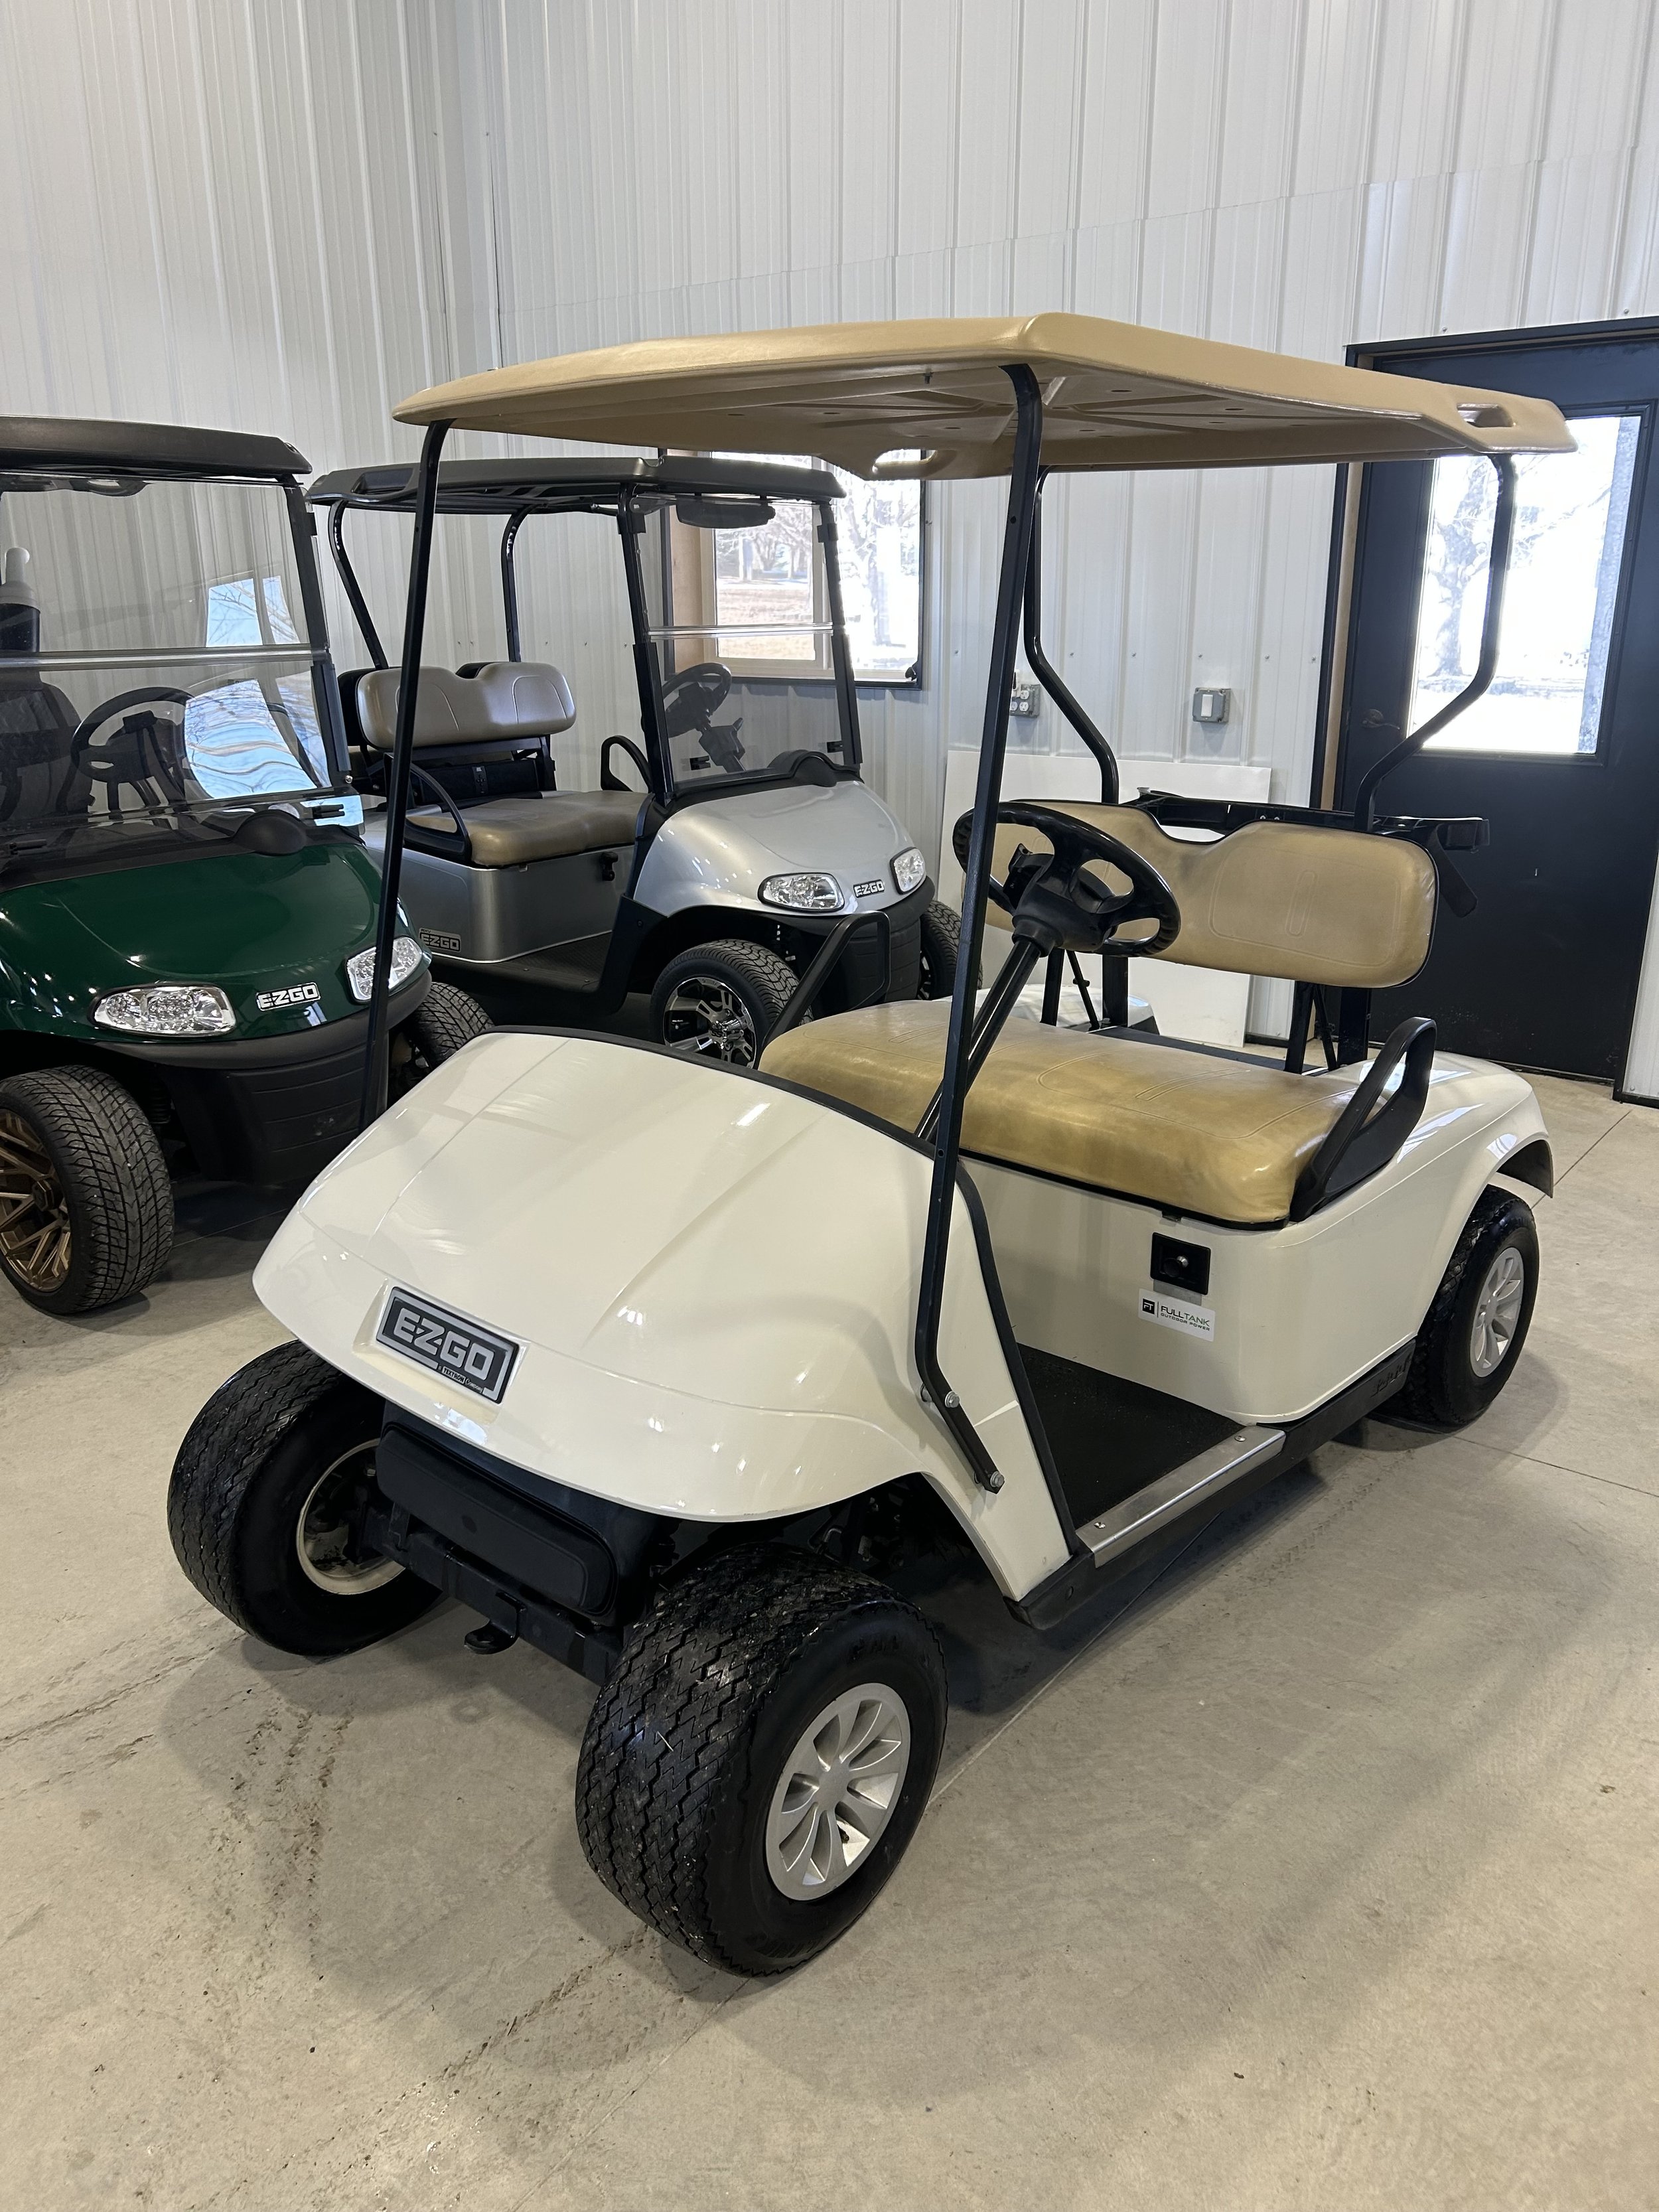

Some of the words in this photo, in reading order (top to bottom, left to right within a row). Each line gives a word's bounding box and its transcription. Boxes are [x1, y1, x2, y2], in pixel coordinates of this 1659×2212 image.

[257, 984, 319, 1008] EZGO
[1161, 1313, 1188, 1324] OUTDOOR
[1189, 1322, 1210, 1331] POWER
[394, 1307, 494, 1380] EZGO
[443, 1367, 465, 1383] TEXTRON
